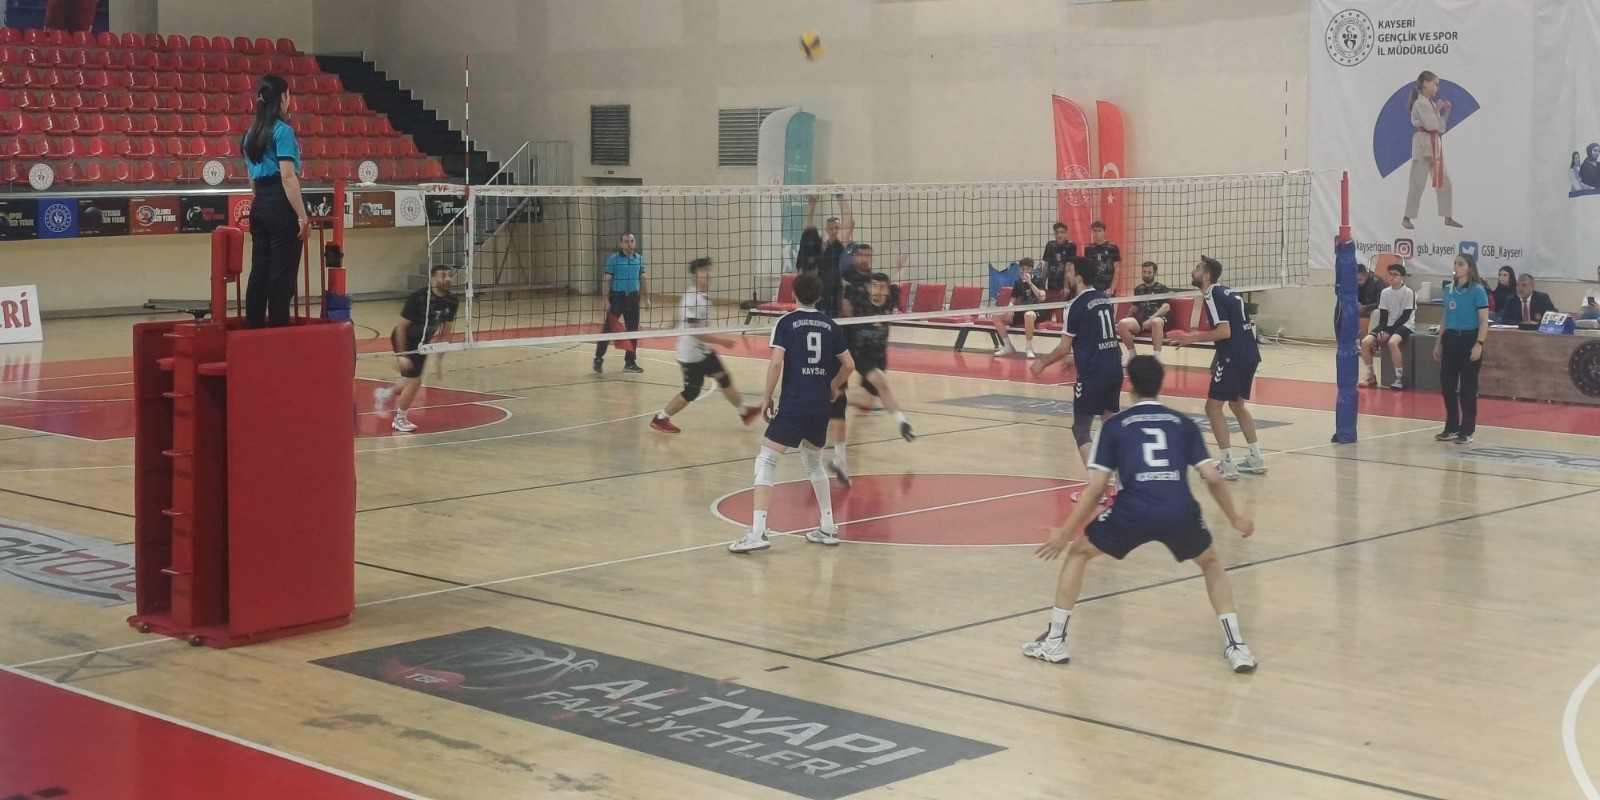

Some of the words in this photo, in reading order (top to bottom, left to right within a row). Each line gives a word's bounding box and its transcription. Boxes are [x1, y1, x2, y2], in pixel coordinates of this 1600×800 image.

[1378, 17, 1415, 29] KAYSERİ
[1378, 31, 1417, 44] GENÇLİK
[1418, 32, 1431, 41] VE
[1432, 31, 1458, 41] SPOR
[1377, 45, 1385, 56] İL
[1387, 43, 1449, 56] MÜDÜRLÜĞÜ
[1416, 241, 1456, 257] gsb_kayseri
[1481, 245, 1523, 260] GSB_Kayseri
[0, 291, 32, 329] Rİ
[1098, 309, 1115, 340] 11
[806, 331, 822, 364] 9
[1140, 427, 1170, 467] 2
[523, 690, 867, 779] FAALİYETLERİ
